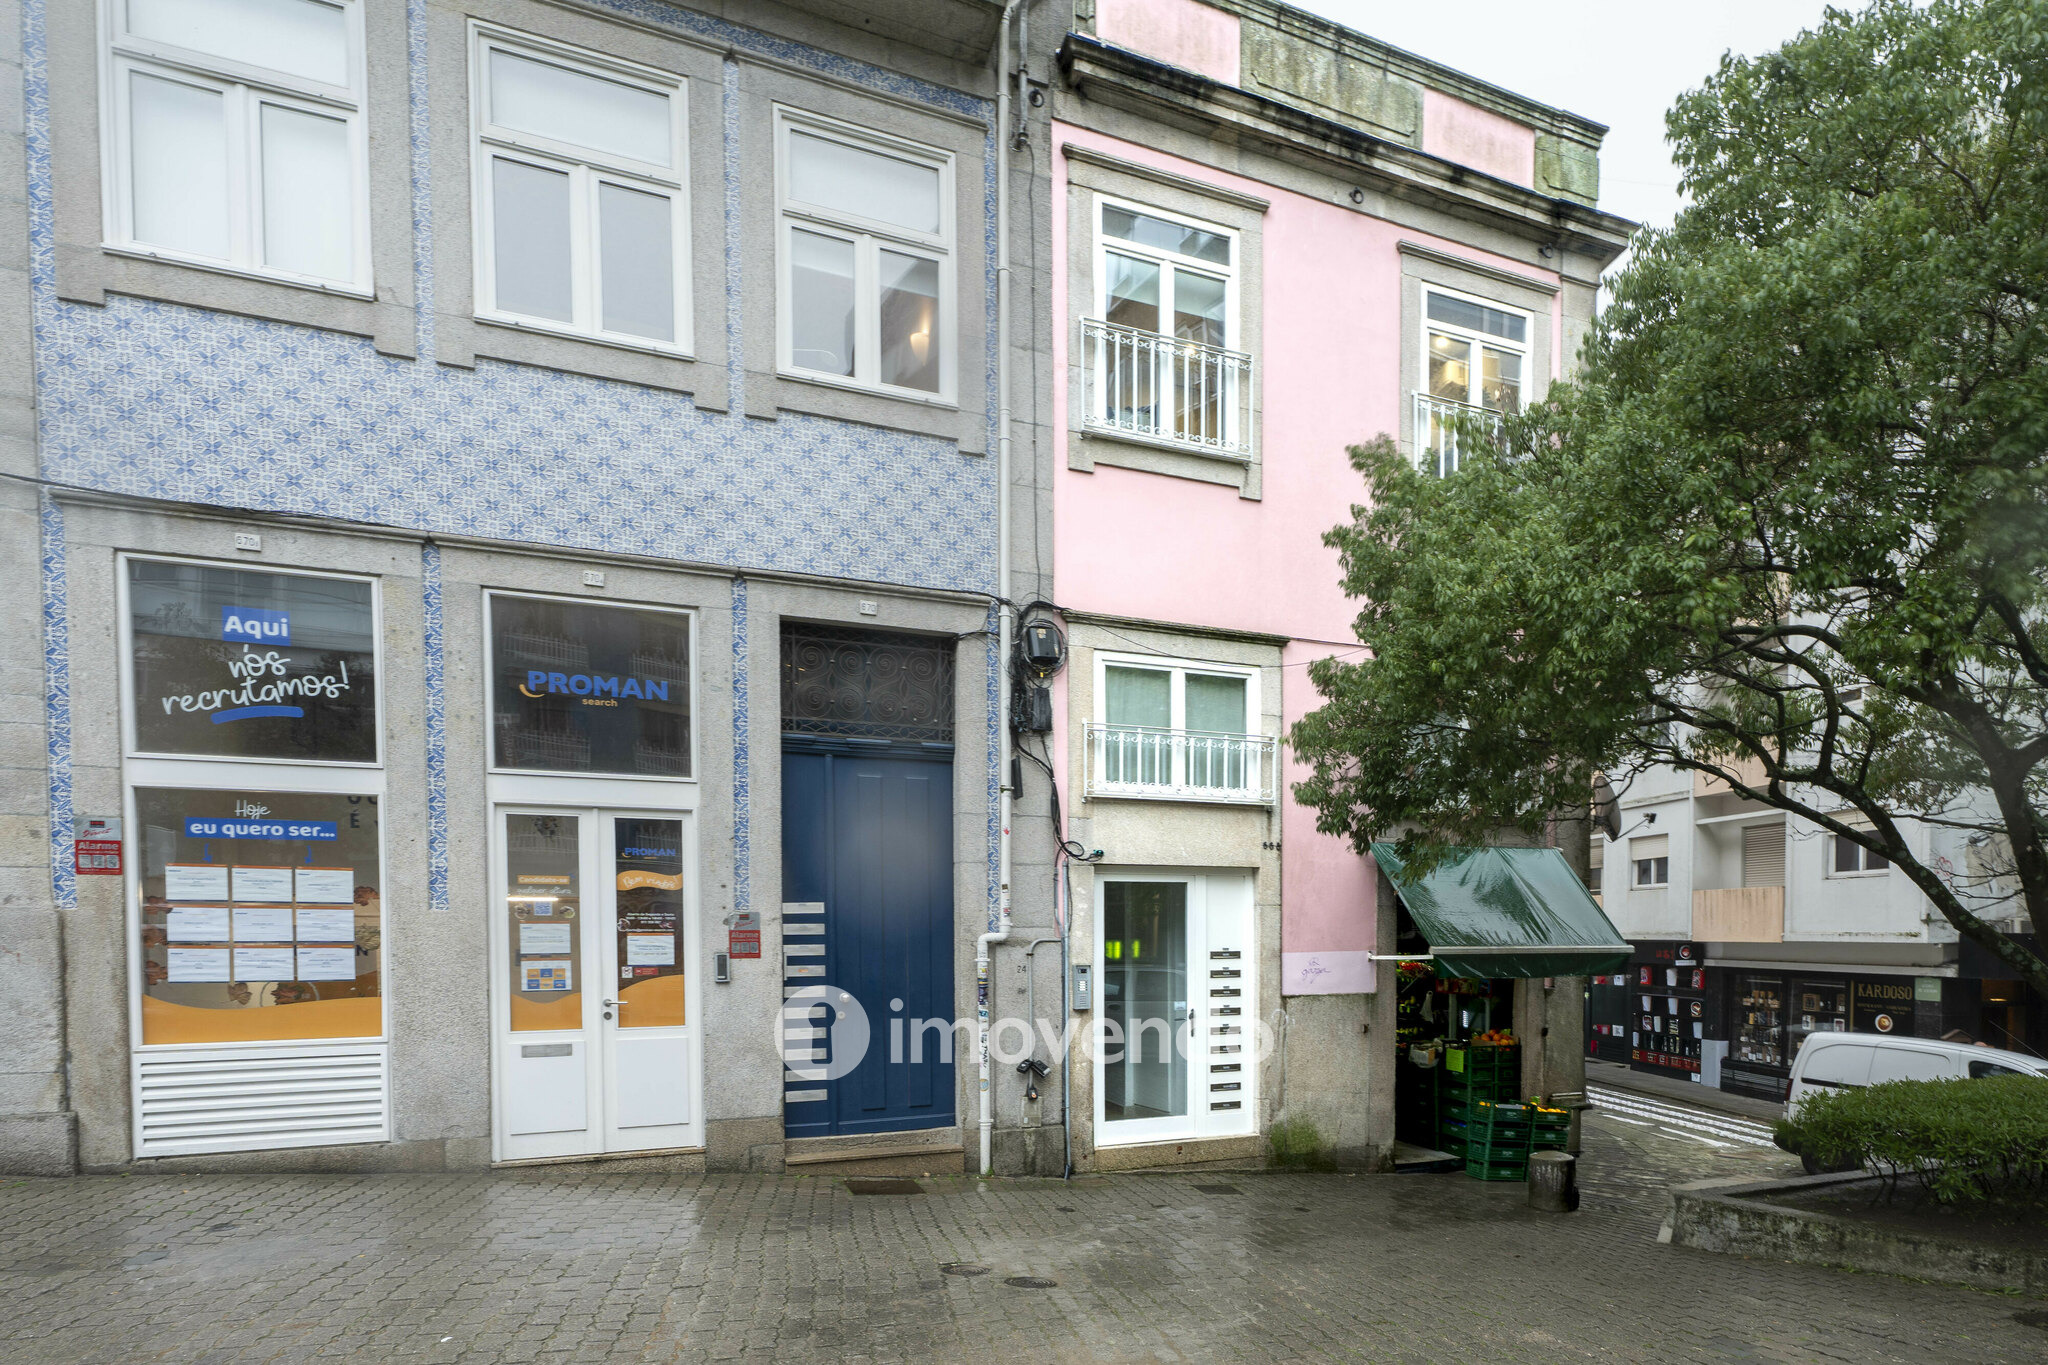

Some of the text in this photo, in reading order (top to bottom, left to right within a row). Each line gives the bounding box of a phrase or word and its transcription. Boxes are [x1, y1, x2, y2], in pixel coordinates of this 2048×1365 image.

[223, 615, 288, 639] Aqui
[228, 644, 291, 678] nós
[162, 661, 350, 715] recrutamos!
[527, 670, 669, 700] PROMAN
[582, 698, 618, 708] search
[234, 800, 271, 819] Hoje
[190, 823, 336, 838] eu quero ser...
[78, 842, 119, 851] Alarme
[624, 847, 676, 857] PROMAN
[1858, 984, 1912, 1000] KARDOSO
